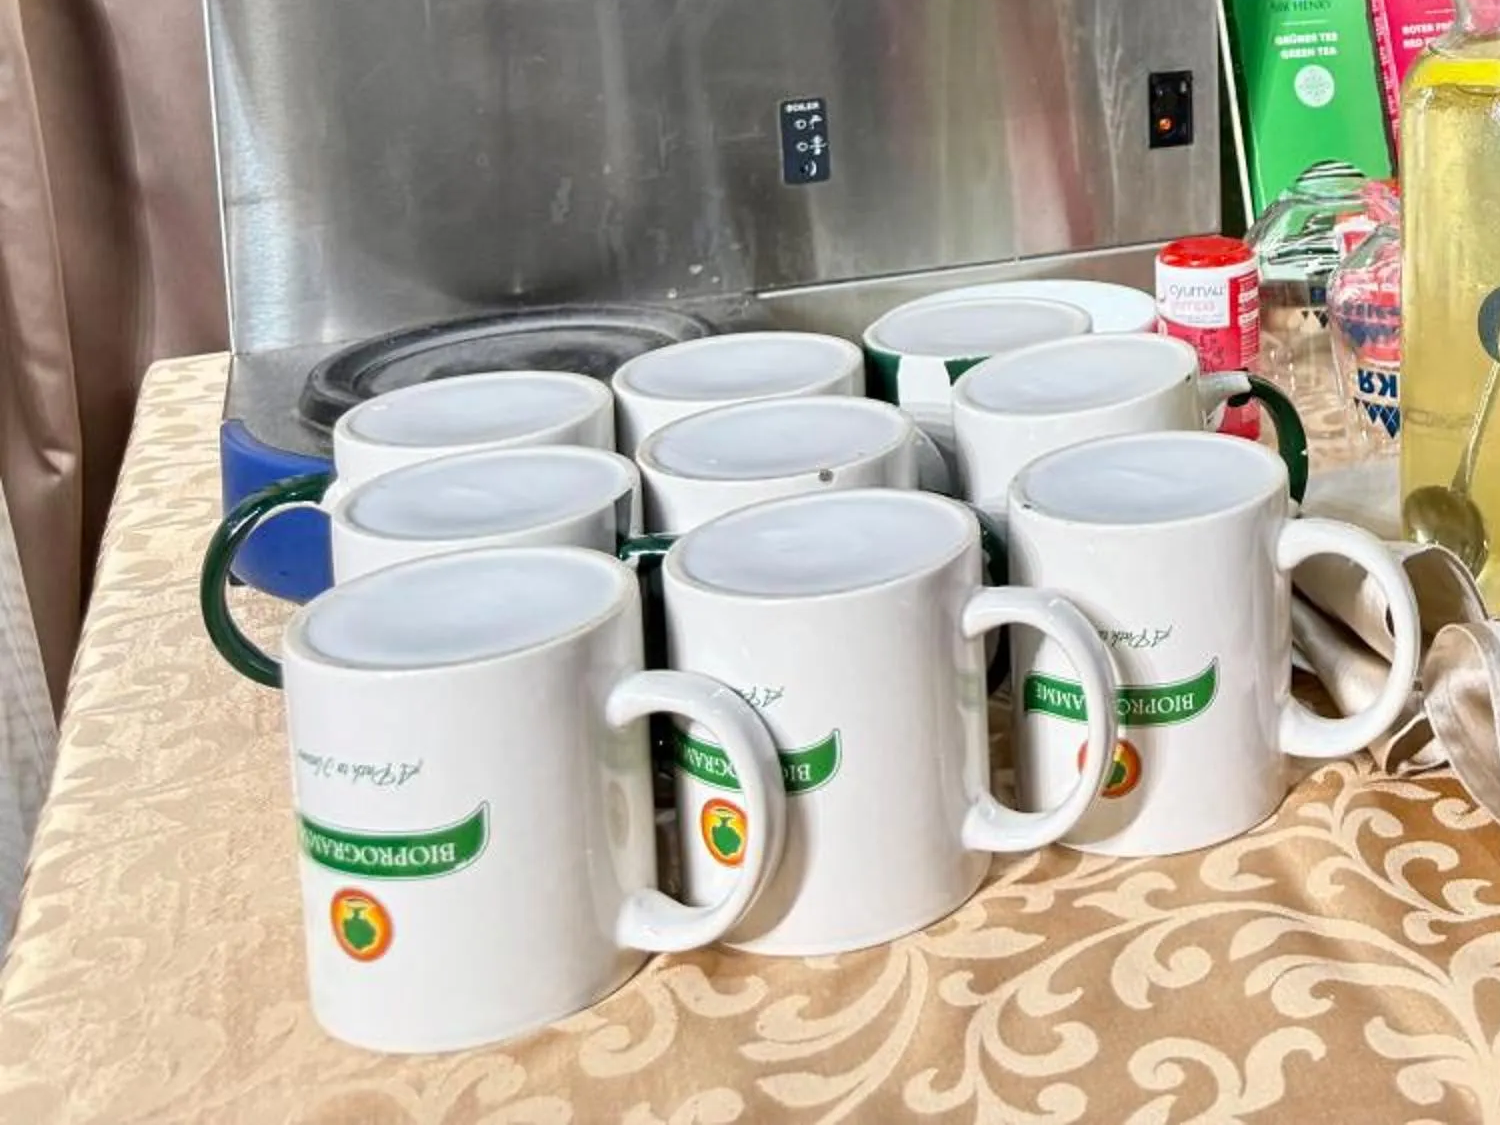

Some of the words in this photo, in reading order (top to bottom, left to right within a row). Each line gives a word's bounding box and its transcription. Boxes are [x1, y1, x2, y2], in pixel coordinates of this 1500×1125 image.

[1318, 30, 1338, 43] TEE
[1280, 47, 1315, 60] GREEN
[1316, 45, 1337, 56] TEA
[1034, 681, 1195, 715] BIOPROAMME
